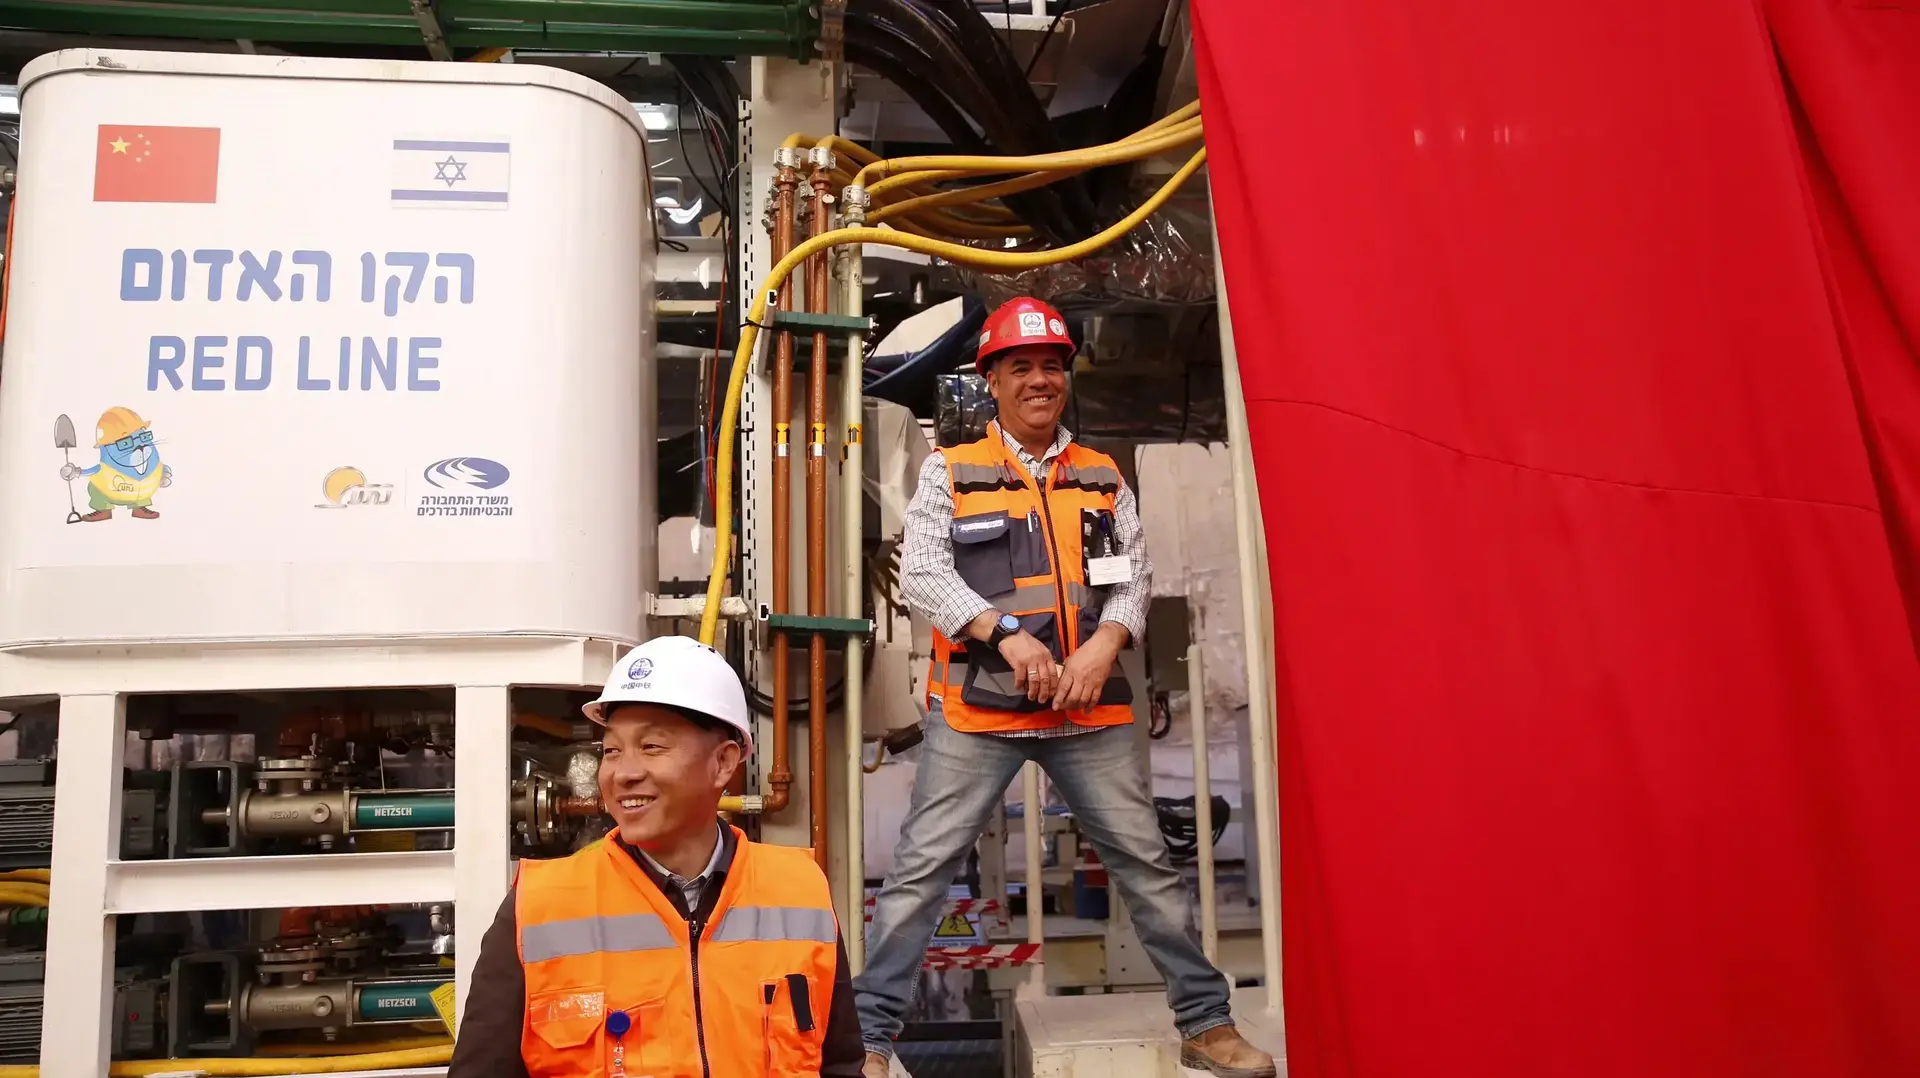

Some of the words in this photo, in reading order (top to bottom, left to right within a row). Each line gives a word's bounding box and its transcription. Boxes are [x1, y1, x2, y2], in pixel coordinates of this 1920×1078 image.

[120, 248, 332, 302] האדום
[360, 251, 475, 317] הקו
[147, 335, 273, 391] RED
[297, 336, 442, 391] LINE
[421, 495, 473, 505] התחבורה
[475, 496, 509, 505] משרד
[416, 506, 458, 516] בדרכים
[460, 506, 513, 516] והבטיחות
[374, 807, 412, 817] NETZSCH
[378, 998, 416, 1008] NETZSCH
